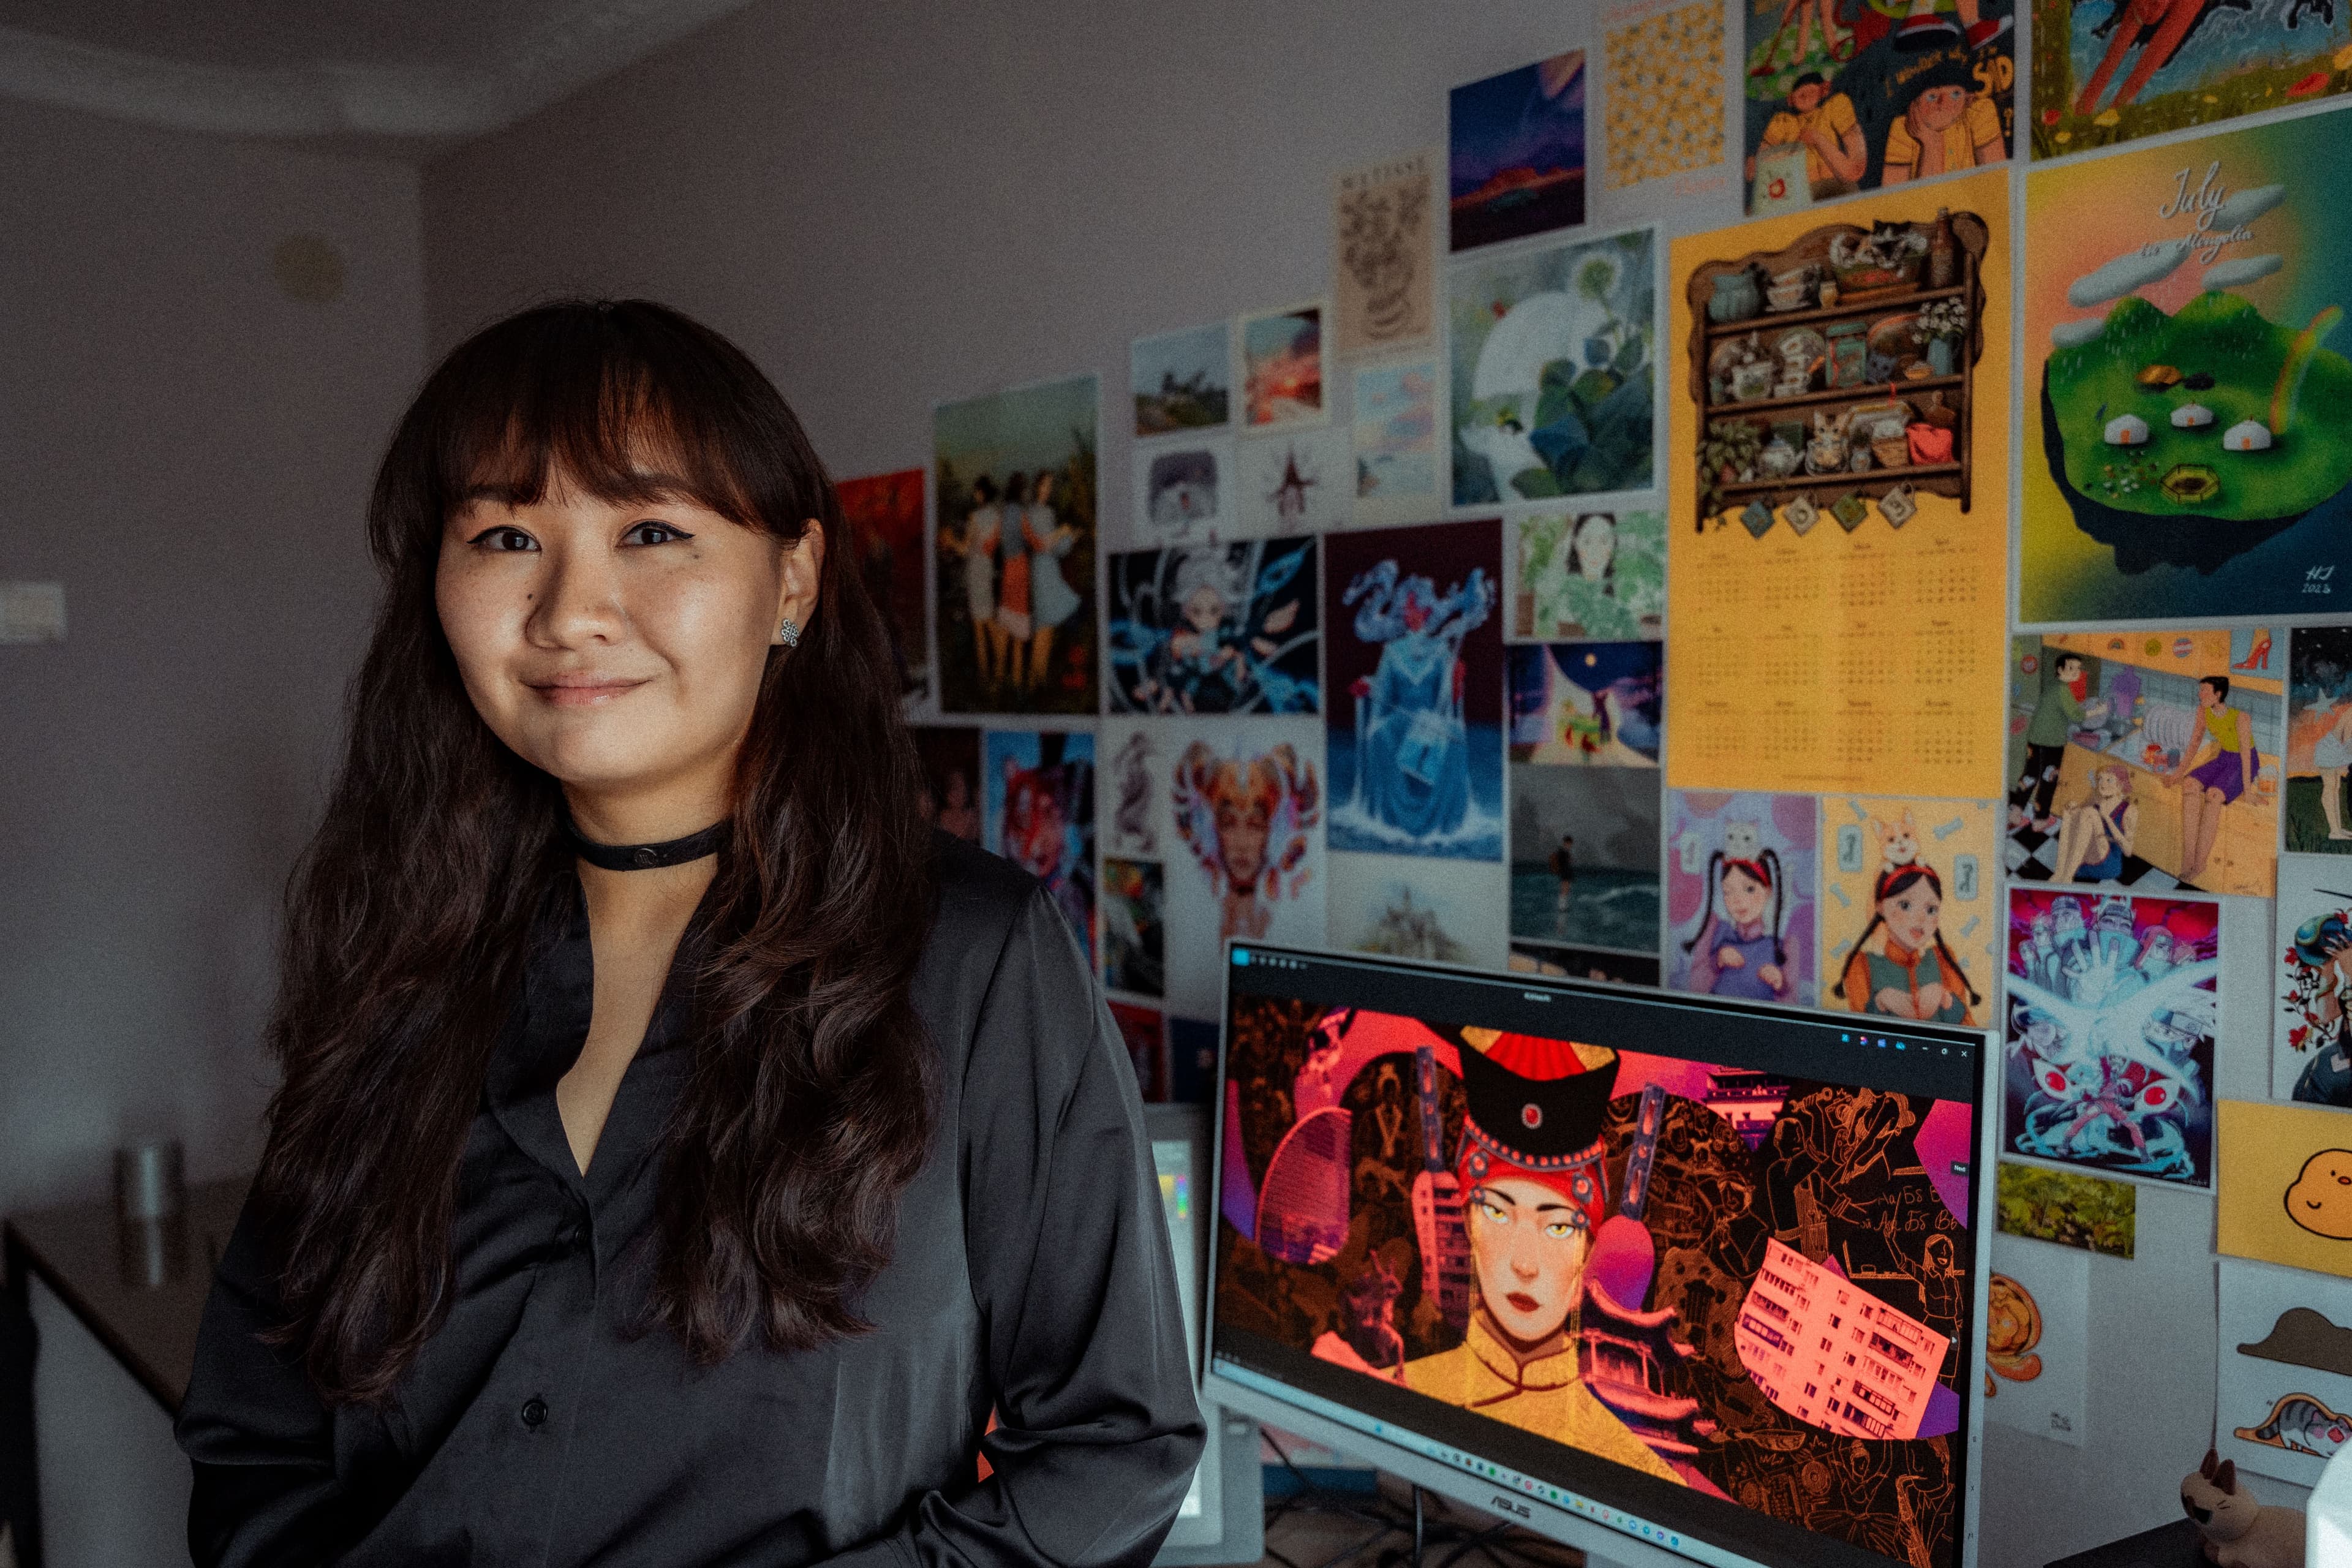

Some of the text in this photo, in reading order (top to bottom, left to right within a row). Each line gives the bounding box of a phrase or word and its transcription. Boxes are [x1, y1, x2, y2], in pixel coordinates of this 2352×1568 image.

[1973, 56, 2014, 99] SAD
[2160, 161, 2228, 232] July
[2176, 225, 2254, 265] Mongolia
[1491, 1496, 1530, 1518] ASUS
